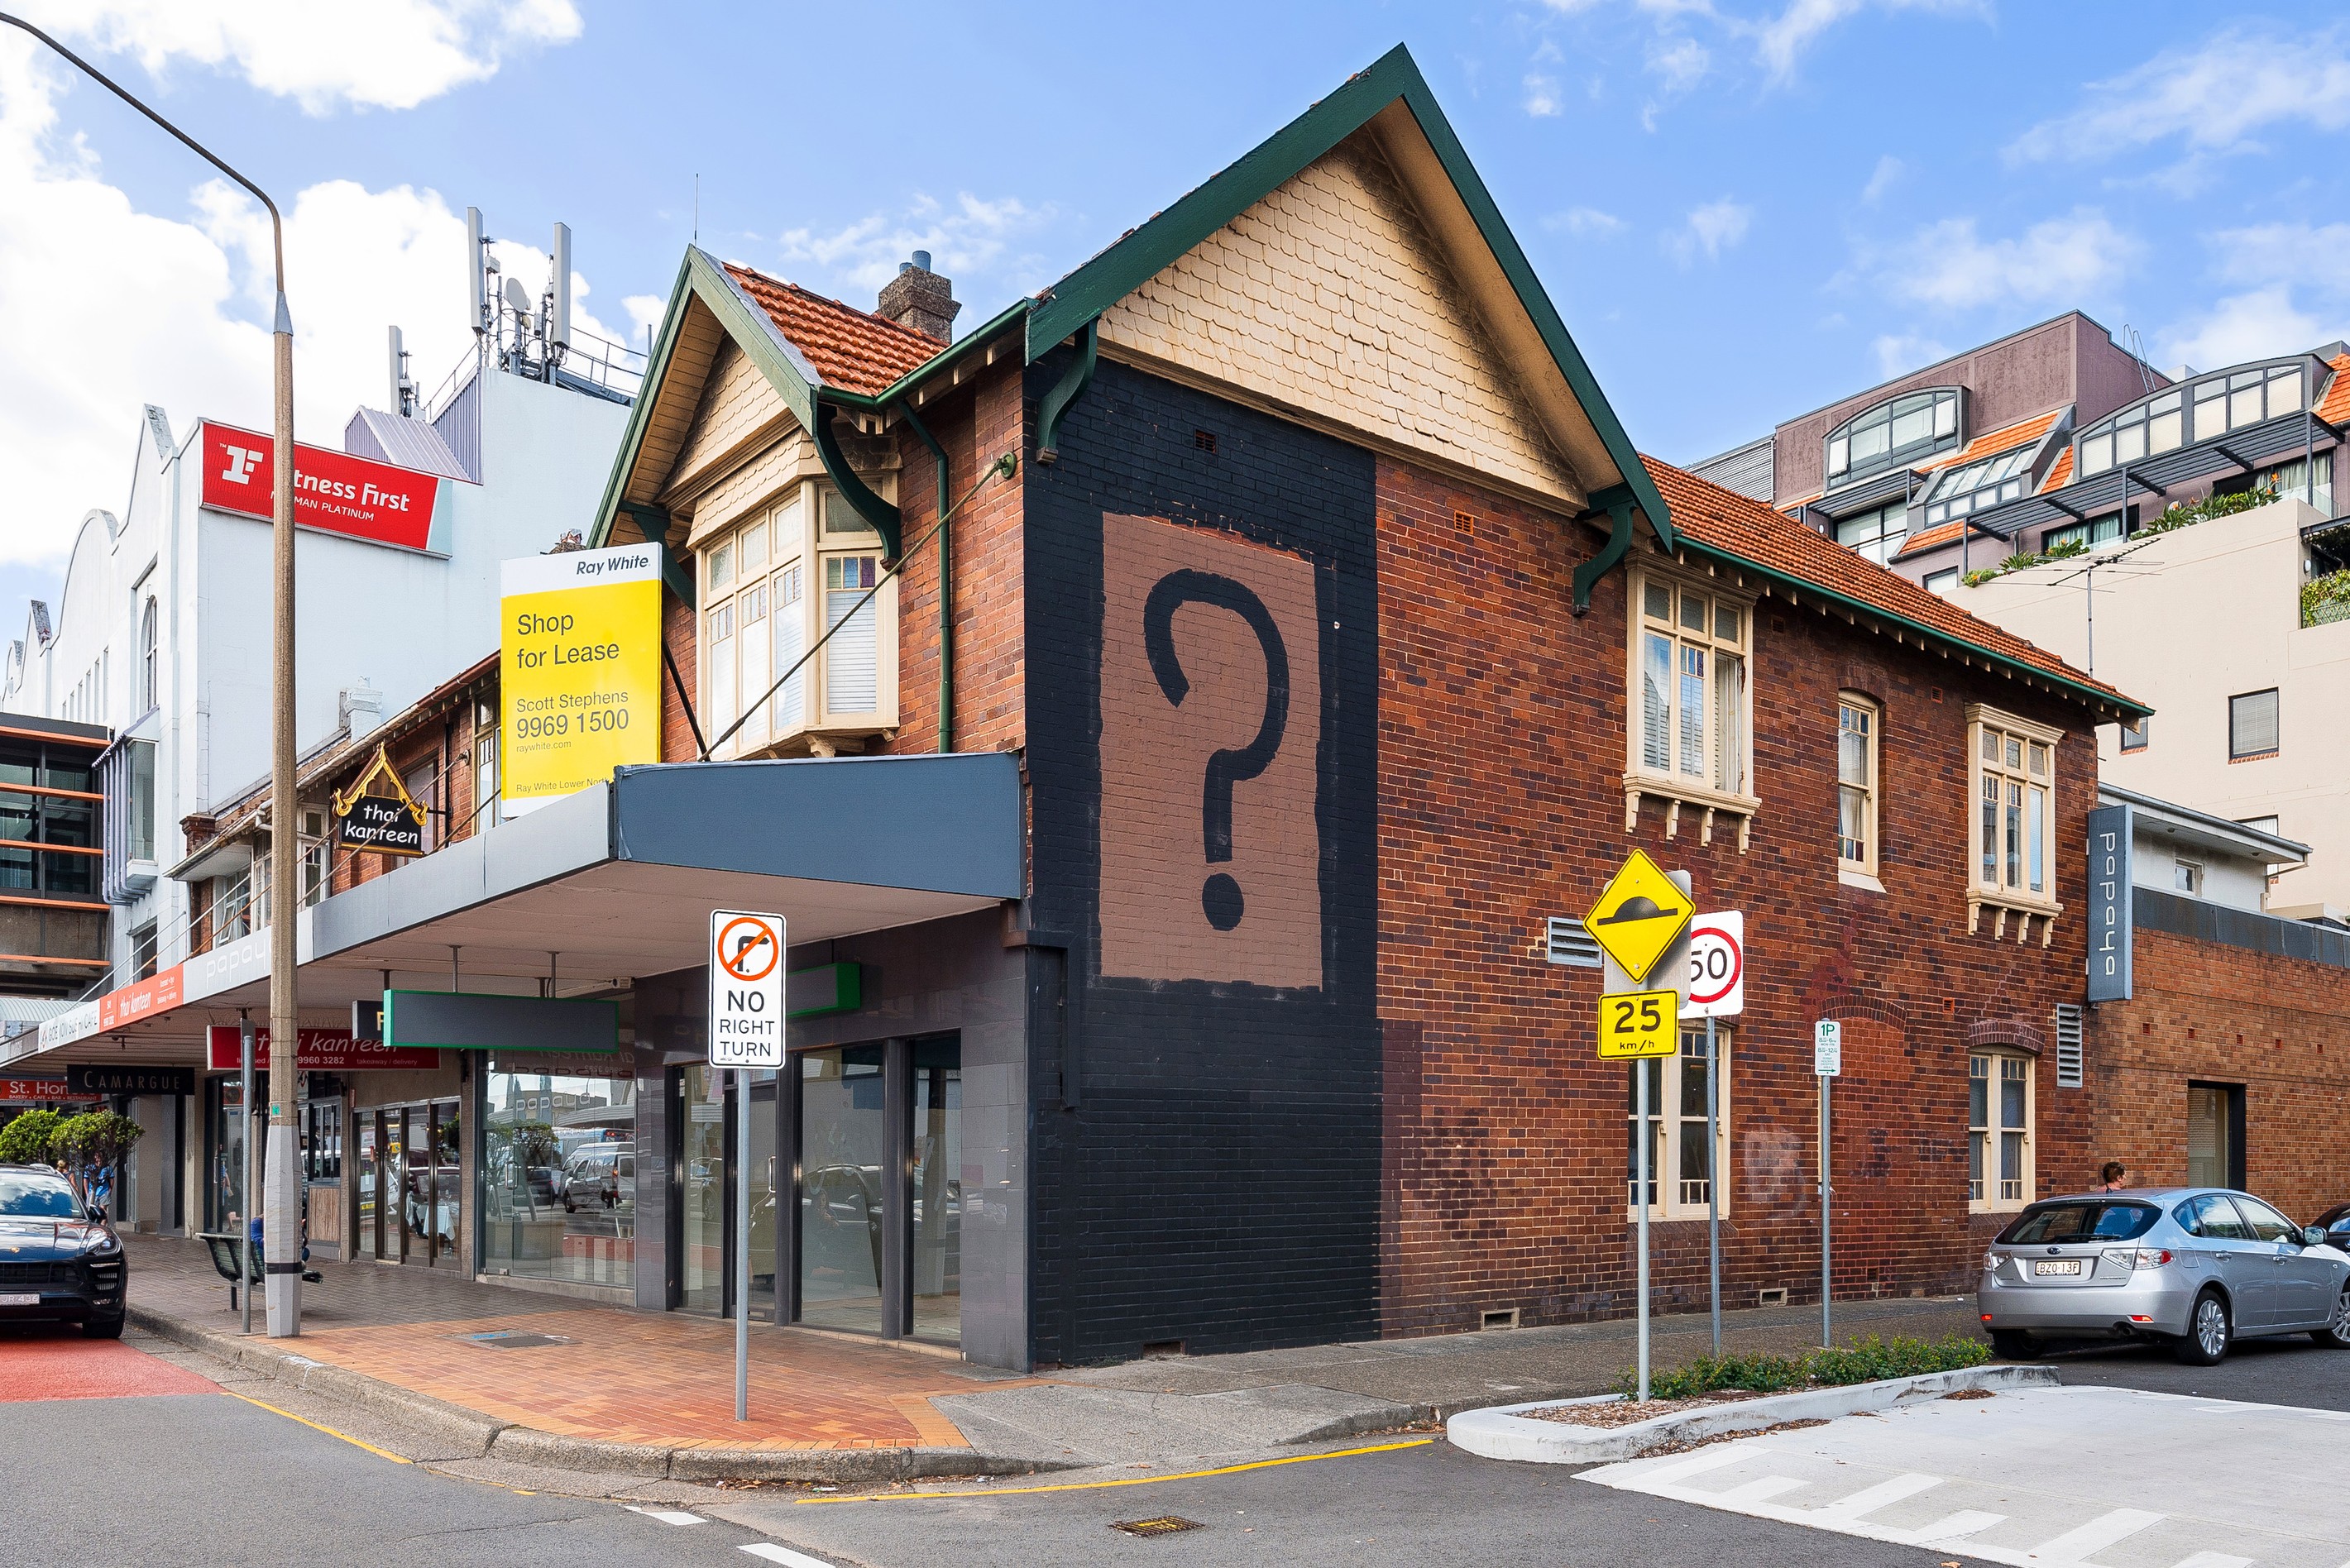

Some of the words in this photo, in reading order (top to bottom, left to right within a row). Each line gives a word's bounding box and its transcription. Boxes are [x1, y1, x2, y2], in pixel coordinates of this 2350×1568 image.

[294, 469, 356, 501] tness
[361, 482, 410, 512] First
[322, 502, 375, 522] PLATINUM
[577, 560, 604, 576] Ray
[608, 555, 649, 572] White
[517, 613, 574, 635] Shop
[517, 648, 547, 668] for
[554, 643, 620, 665] Lease
[516, 697, 554, 712] Scott
[559, 691, 629, 710] Stephens
[516, 714, 569, 739] 9969
[577, 708, 629, 734] 1500
[516, 739, 572, 753] raywhite.com
[516, 784, 532, 794] Ray
[534, 782, 557, 791] White
[559, 779, 584, 789] Lower
[364, 804, 400, 823] thai
[345, 820, 419, 844] kanteen
[2099, 832, 2116, 976] papaya
[207, 939, 271, 991] papay
[1691, 948, 1727, 982] 50
[728, 990, 765, 1012] NO
[720, 1019, 775, 1035] RIGHT
[1614, 999, 1661, 1034] 25
[1821, 1023, 1835, 1036] 1P
[258, 1033, 304, 1051] ti
[720, 1040, 771, 1057] TURN
[1620, 1040, 1654, 1052] km/h
[298, 1056, 320, 1064] 9960
[323, 1056, 344, 1064] 3282
[357, 1058, 387, 1066] takeaway
[392, 1058, 418, 1066] delivery
[9, 1080, 30, 1094] St.
[84, 1070, 180, 1090] CAMARGUE
[515, 1092, 591, 1120] papaya
